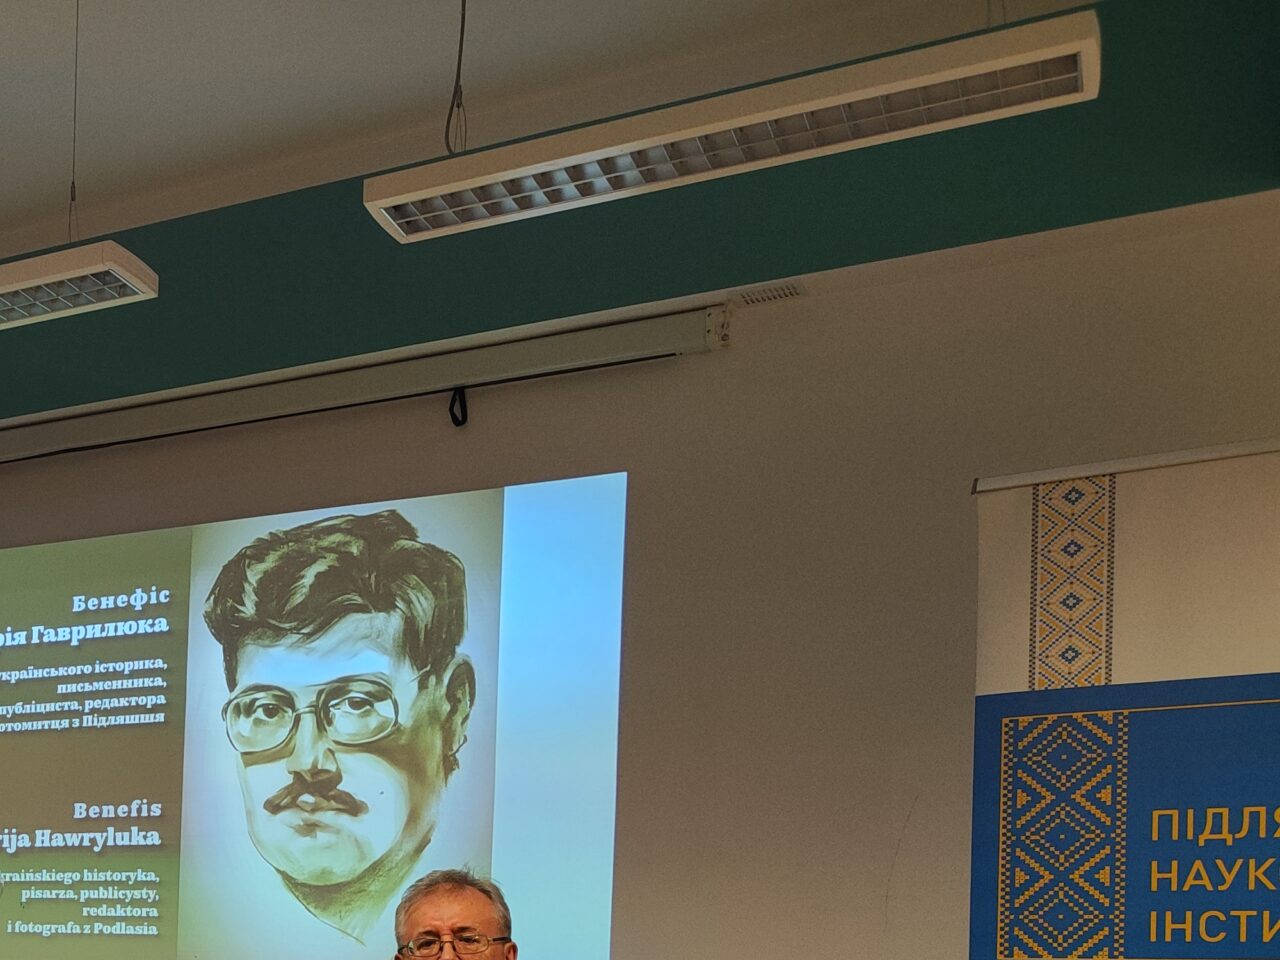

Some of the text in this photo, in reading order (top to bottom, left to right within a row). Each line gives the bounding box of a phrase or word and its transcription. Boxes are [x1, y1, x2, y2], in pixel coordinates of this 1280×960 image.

[72, 586, 170, 612] Бенефіс
[31, 617, 169, 646] Гаврилюка
[94, 658, 168, 675] історика,
[56, 677, 167, 694] письменника,
[84, 695, 166, 713] редактора
[71, 718, 80, 728] з
[82, 712, 165, 727] Підляшшя
[73, 799, 162, 819] Benefis
[1152, 805, 1280, 847] ПІДЛ
[34, 826, 161, 852] Hawryluka
[83, 869, 160, 885] historyka,
[1150, 857, 1280, 893] НАУК
[21, 887, 160, 902] pisarza, publicysty,
[82, 905, 159, 917] redaktora
[7, 920, 159, 936] i fotografa z Podlasia
